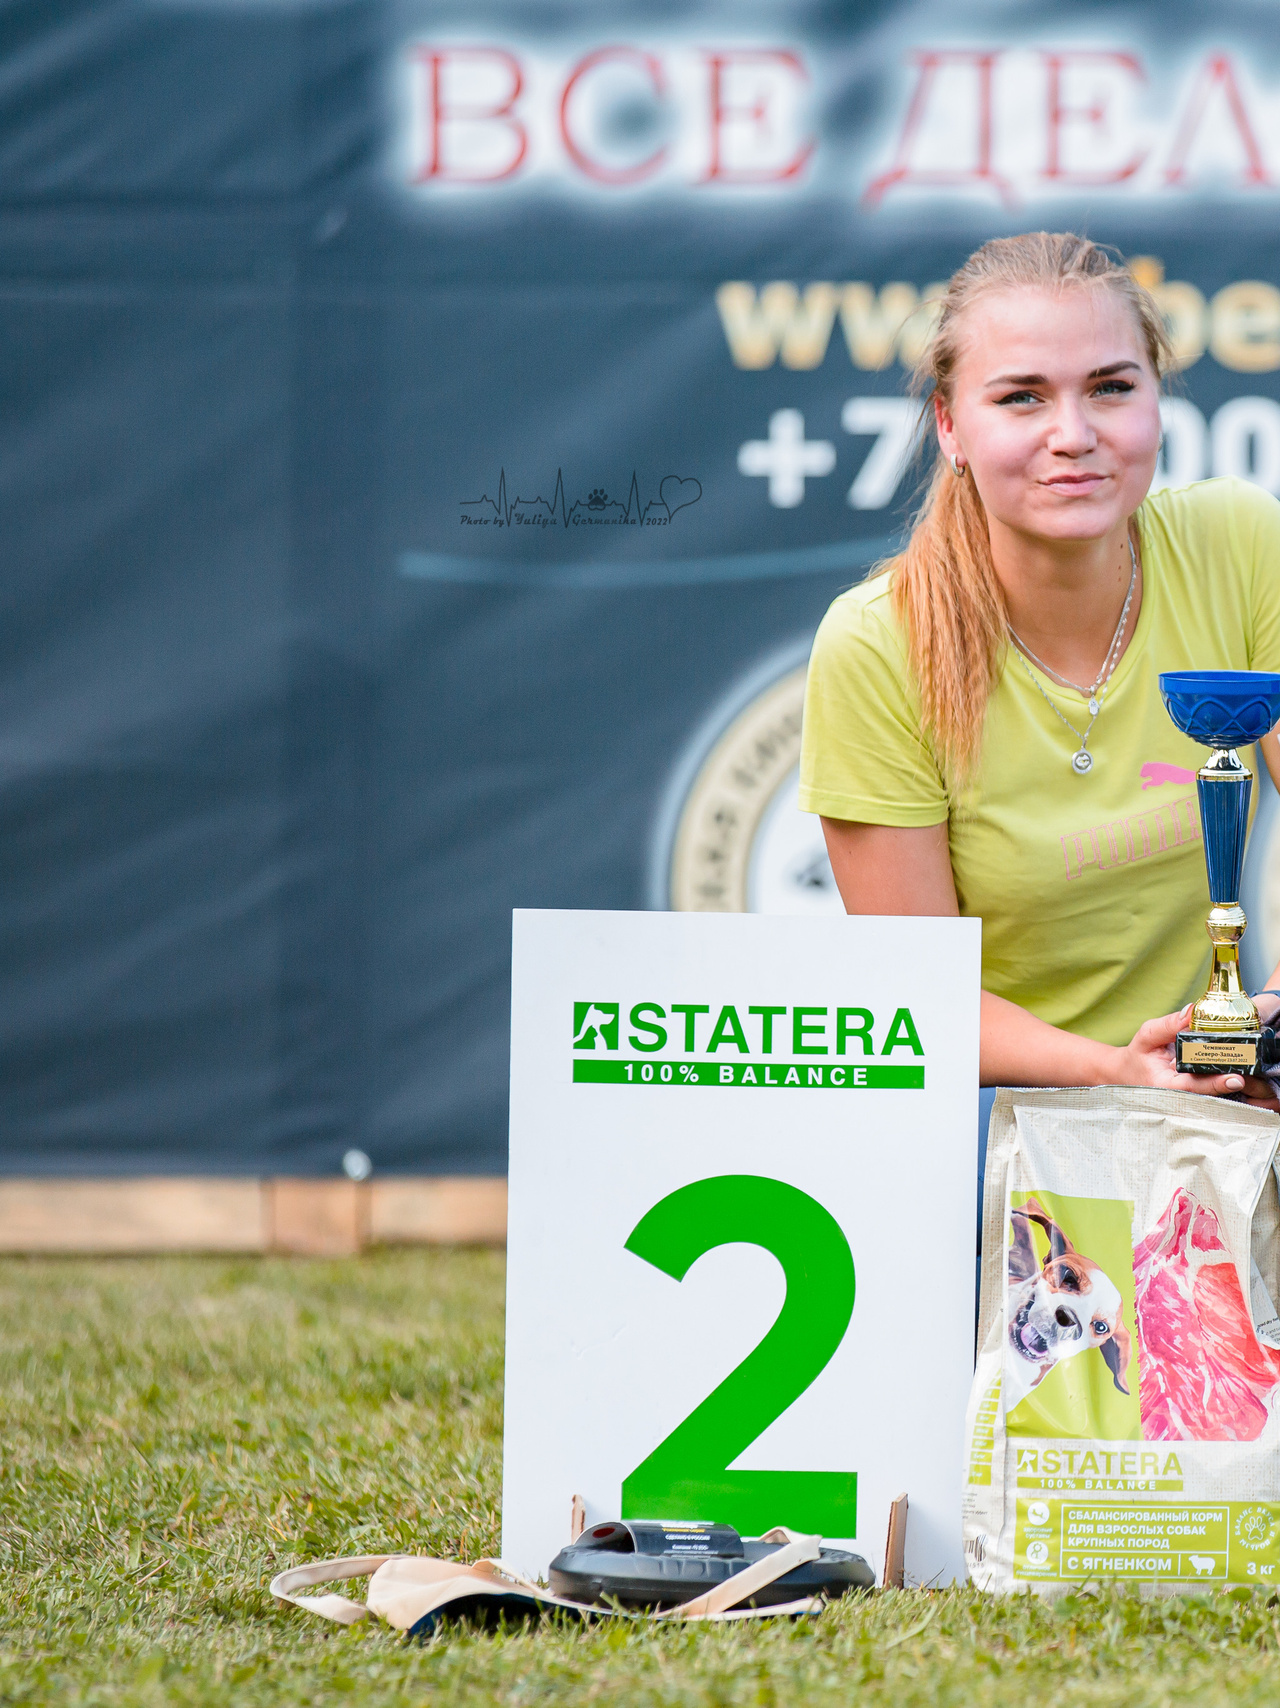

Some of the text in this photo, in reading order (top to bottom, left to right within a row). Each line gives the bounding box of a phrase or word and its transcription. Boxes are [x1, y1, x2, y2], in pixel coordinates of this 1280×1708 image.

[410, 46, 816, 187] ВСЕ
[628, 1001, 926, 1056] STATERA
[624, 1064, 869, 1086] 100% BALANCE
[620, 1174, 858, 1539] 2
[1042, 1450, 1183, 1476] STATERA
[1040, 1479, 1157, 1490] 100% BALANCE
[1068, 1510, 1223, 1522] СБАЛАНСИРОВАННЫЙ КОРМ
[1068, 1524, 1206, 1536] ДЛЯ ВЗРОСЛЫХ СОБАК
[1068, 1537, 1170, 1549] КРУПНЫХ ПОРОД
[1067, 1557, 1172, 1571] С ЯГНЕНКОМ
[1246, 1562, 1275, 1575] 3 кг
